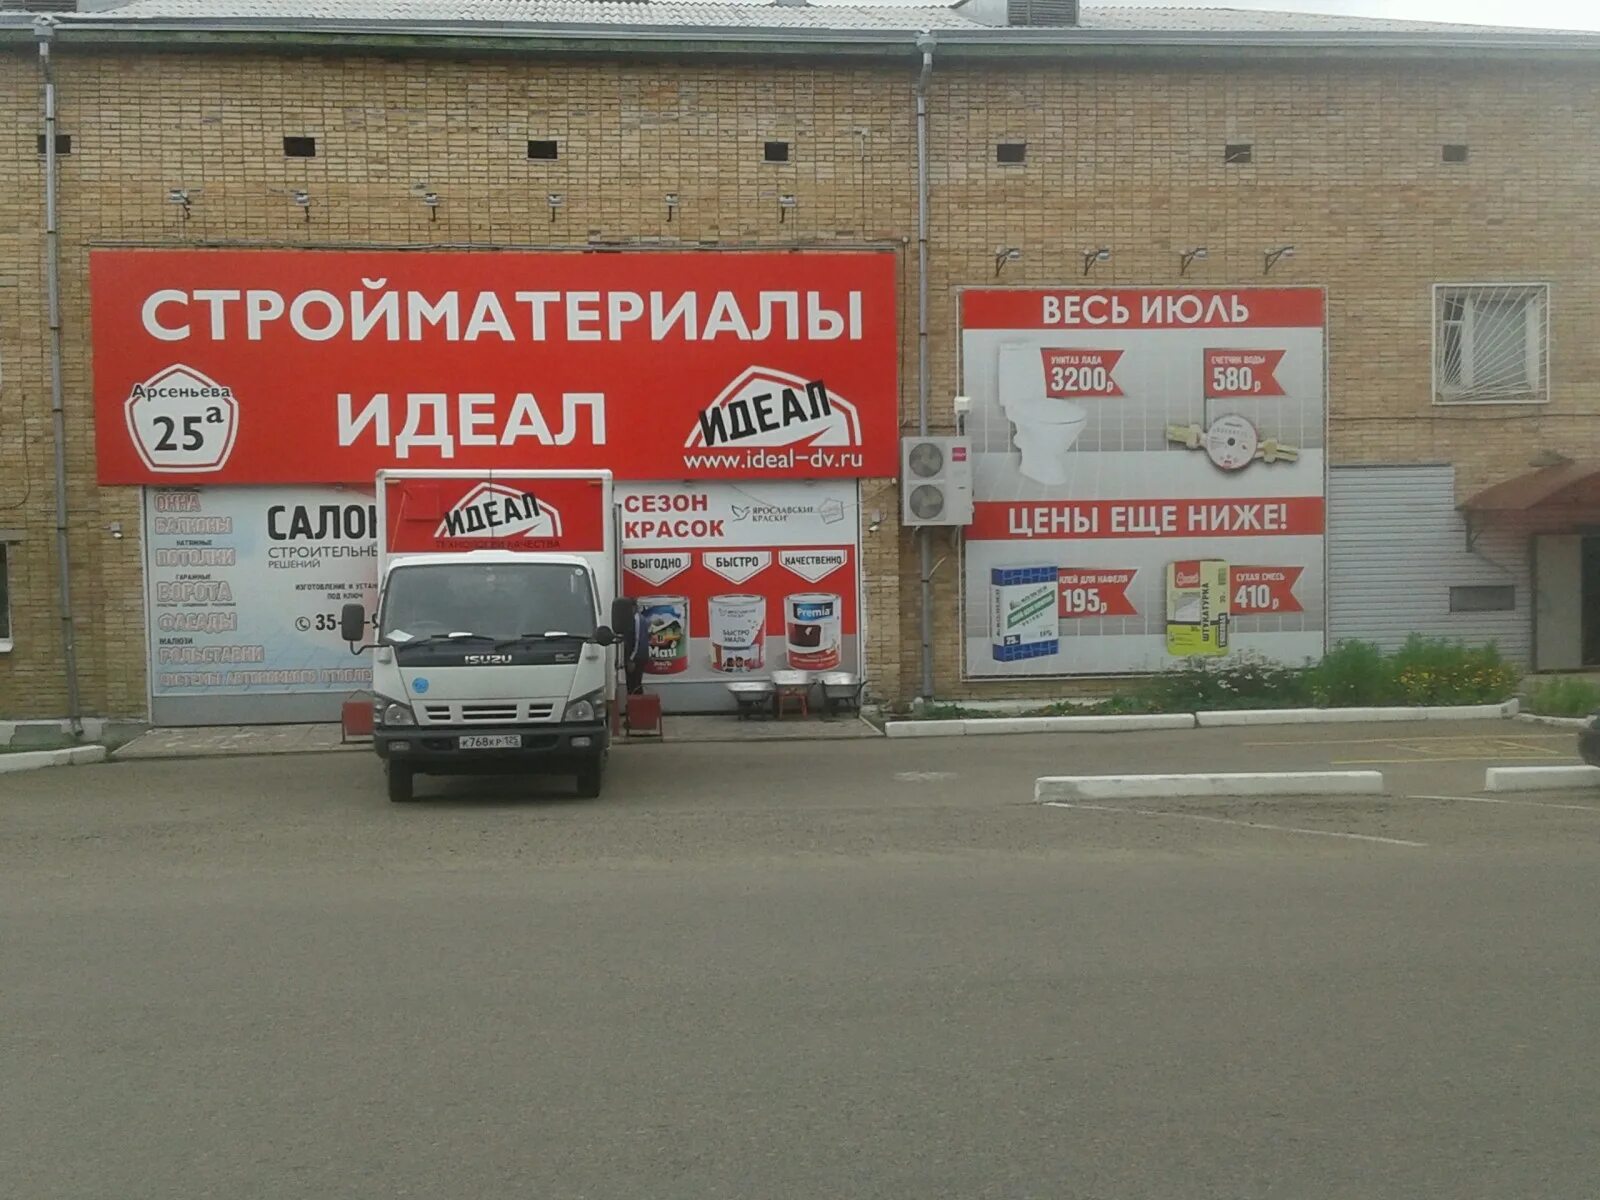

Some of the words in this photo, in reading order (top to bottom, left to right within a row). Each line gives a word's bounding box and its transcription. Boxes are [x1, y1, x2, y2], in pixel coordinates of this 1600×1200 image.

[141, 278, 863, 342] СТРОЙМАТЕРИАЛЫ
[1042, 294, 1129, 325] ВЕСЬ
[1141, 293, 1249, 324] ИЮЛЬ
[132, 384, 231, 401] Арсеньева
[699, 379, 832, 447] ИДЕАЛ
[337, 393, 606, 458] ИДЕАЛ
[683, 448, 863, 469] www.ideal-dv.ru
[624, 494, 708, 513] СЕЗОН
[444, 491, 540, 537] ИДЕАЛ
[1009, 506, 1098, 537] ЦЕНЫ
[1111, 505, 1177, 535] ЕЩЕ
[1188, 503, 1288, 532] НИЖЕ!
[624, 519, 724, 539] КРАСОК
[268, 557, 320, 569] РЕШЕНИЙ
[631, 557, 682, 569] ВЫГОДНО
[715, 556, 759, 568] БЫСТРО
[785, 555, 842, 566] КАЧЕСТВЕННО
[796, 605, 831, 616] Premia
[464, 654, 512, 664] ISUZU
